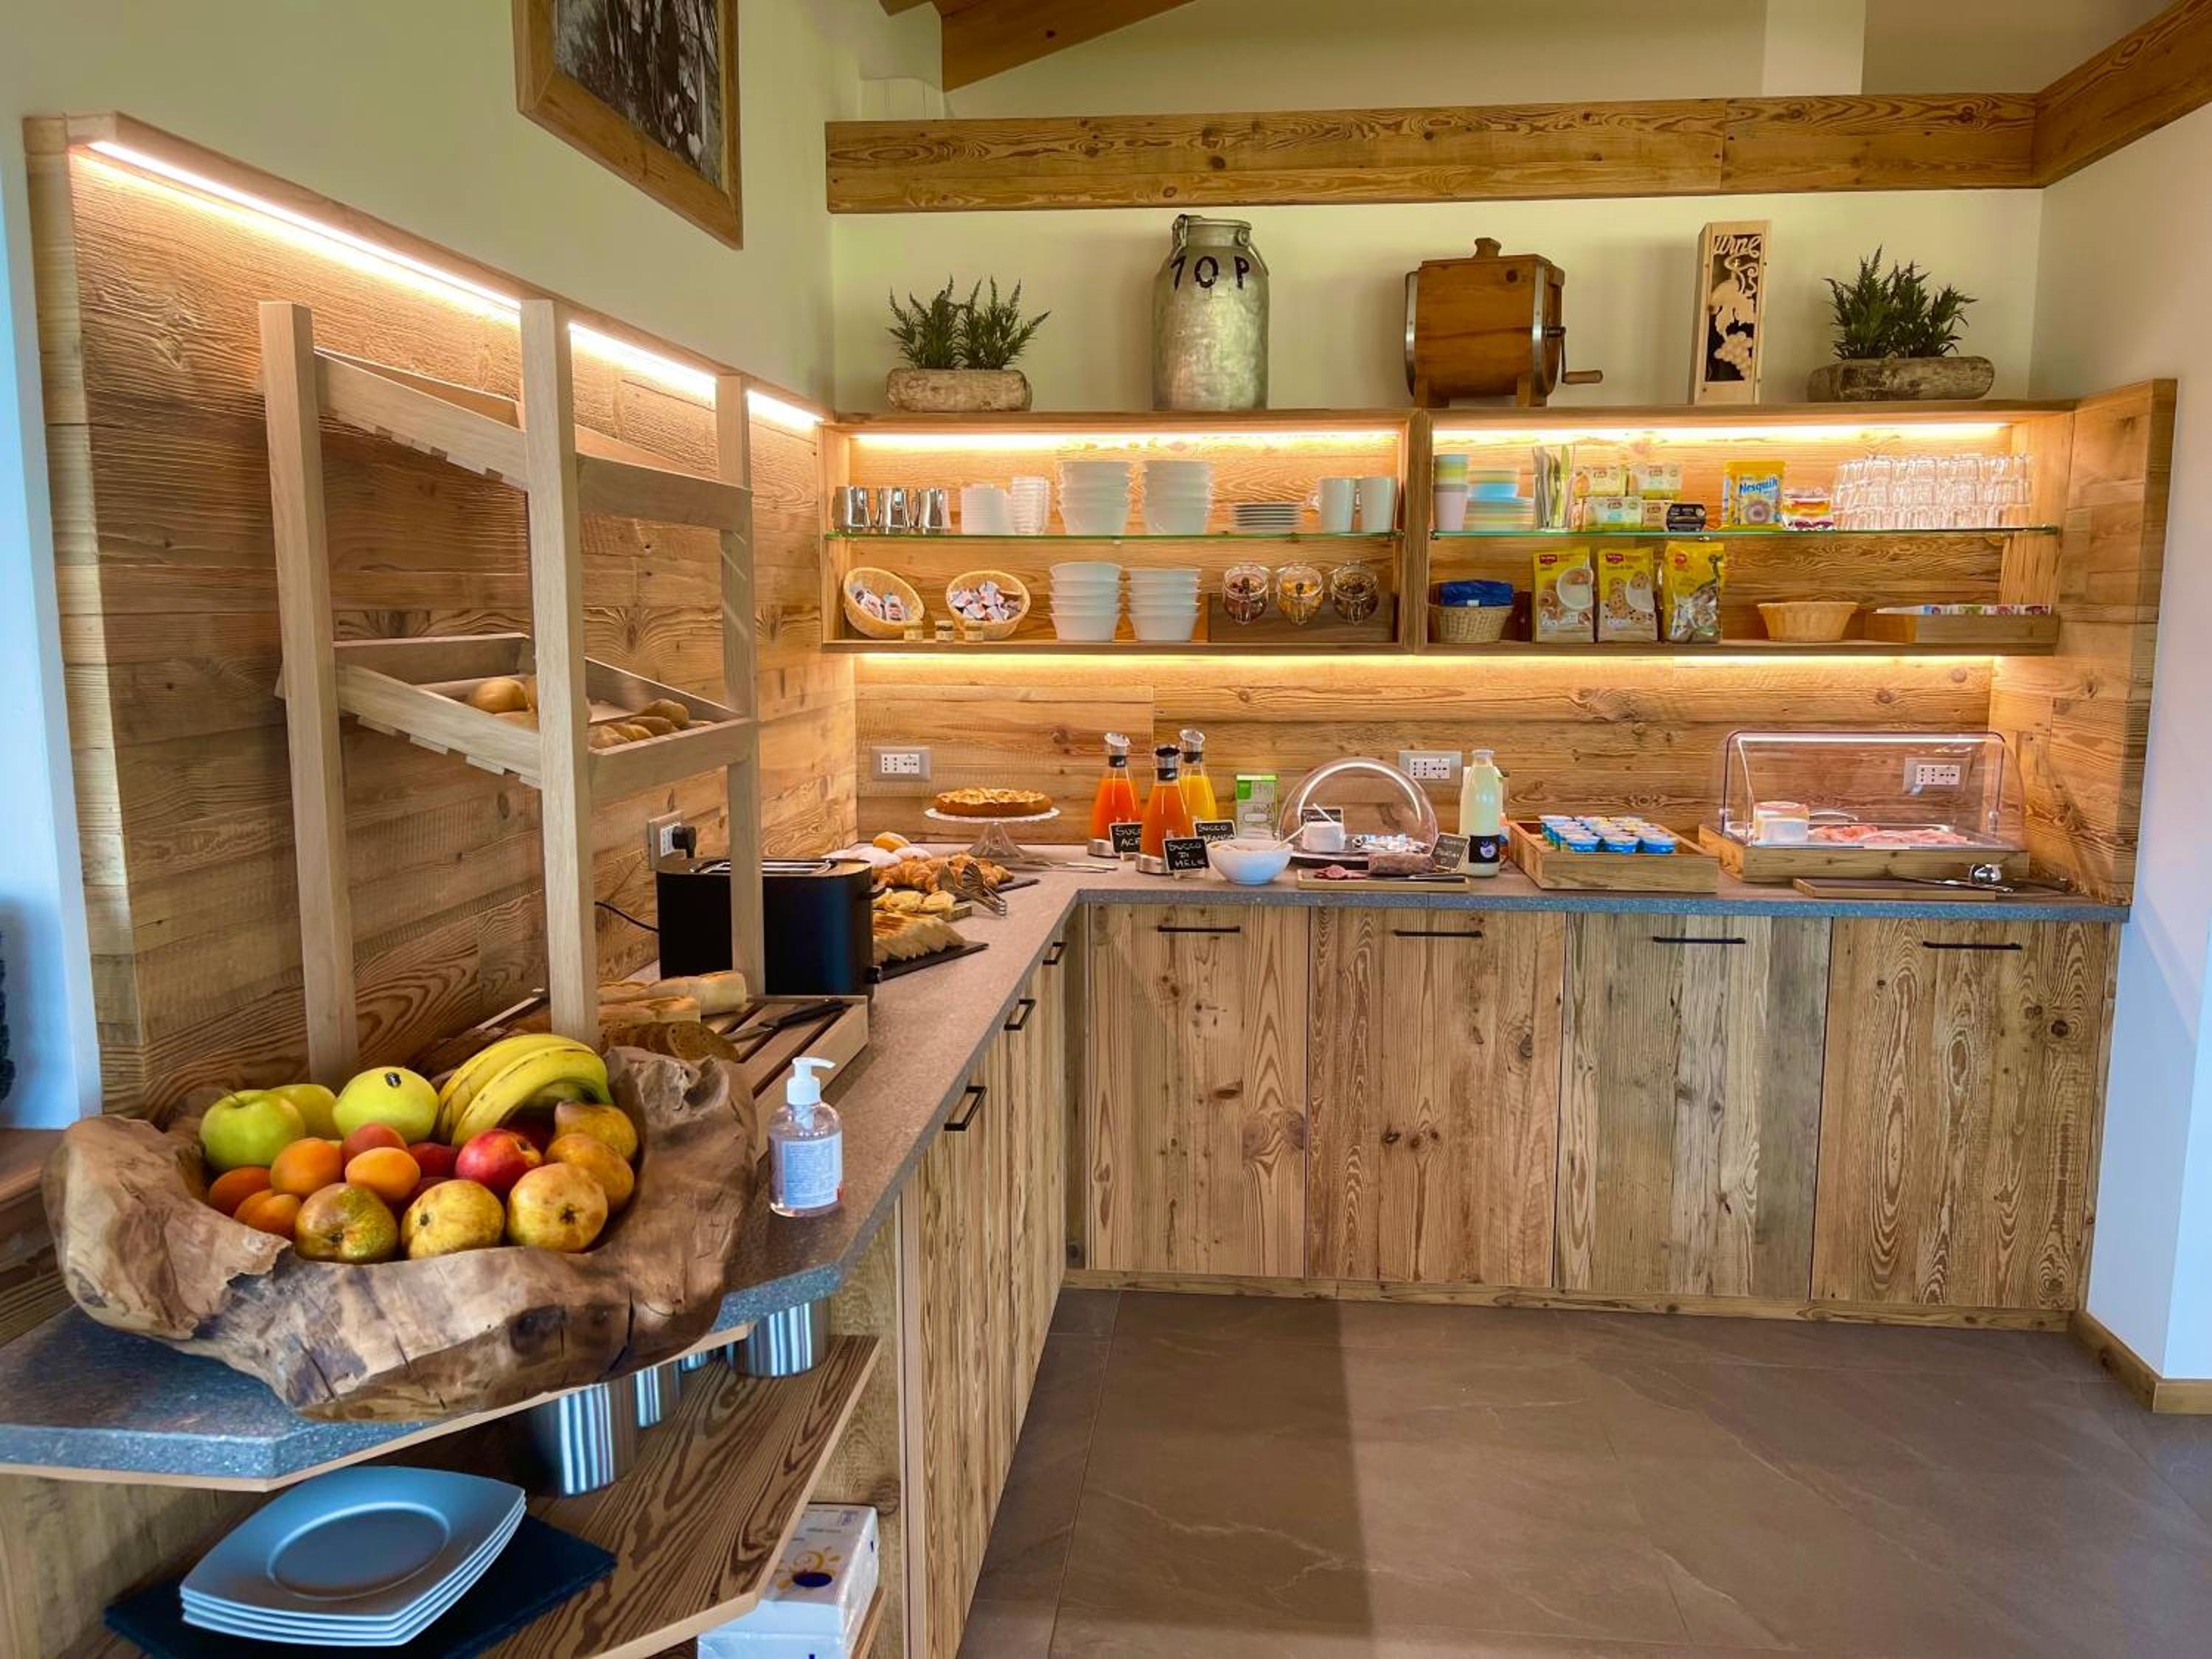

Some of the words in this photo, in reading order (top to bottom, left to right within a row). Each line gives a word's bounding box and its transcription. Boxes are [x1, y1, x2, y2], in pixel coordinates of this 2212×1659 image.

[1739, 476, 1778, 494] Nesquik
[1167, 841, 1202, 852] SUCCO
[1175, 858, 1206, 869] MELE
